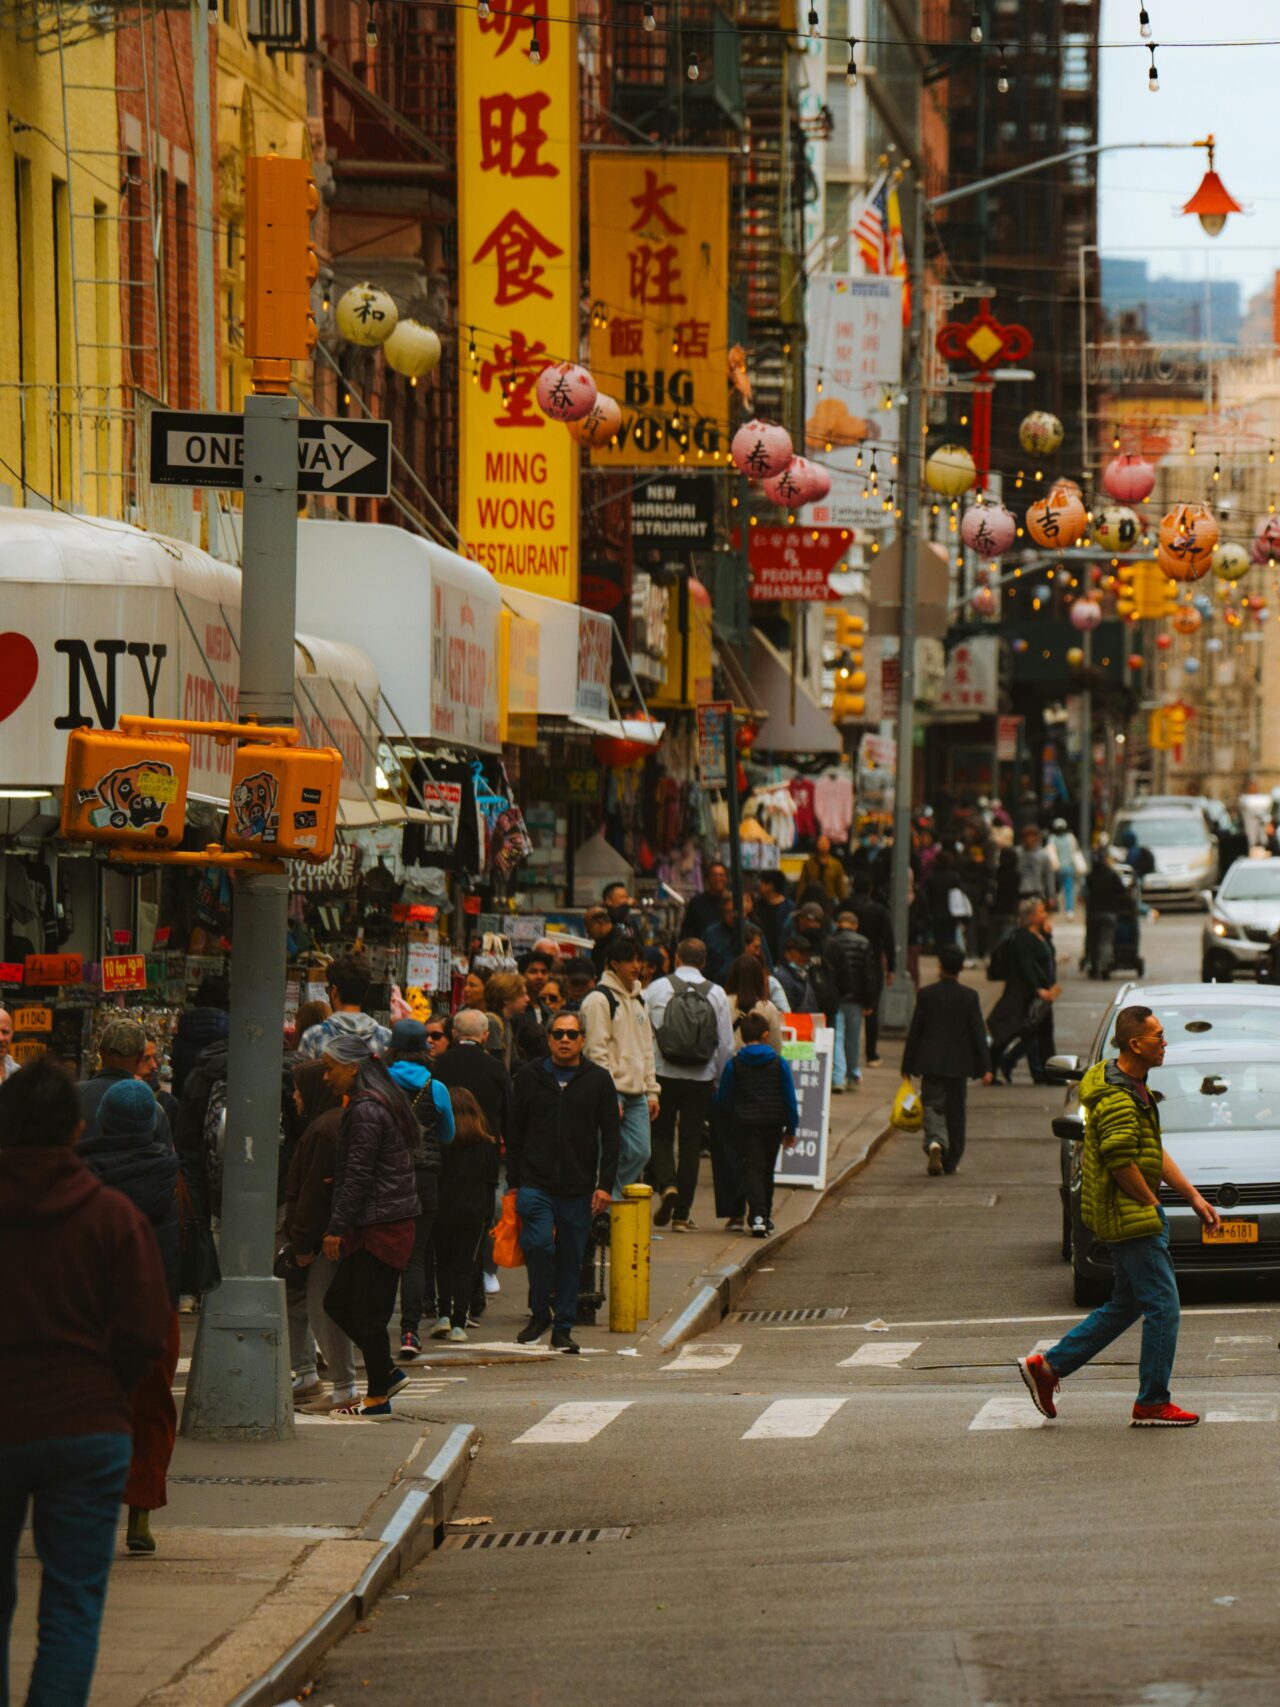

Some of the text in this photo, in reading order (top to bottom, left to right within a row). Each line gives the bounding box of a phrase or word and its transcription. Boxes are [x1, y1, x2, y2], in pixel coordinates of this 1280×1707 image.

[627, 168, 687, 306] 大旺
[353, 302, 385, 324] 和
[609, 317, 711, 359] 飯店
[550, 376, 574, 410] 春
[624, 369, 694, 407] BIG
[186, 435, 244, 465] ONE
[607, 414, 720, 454] WONG
[485, 451, 547, 484] MING
[746, 441, 771, 474] 春
[646, 484, 677, 501] NEW
[775, 471, 801, 499] 春
[477, 498, 555, 531] WONG
[632, 503, 697, 519] SHANGHAI
[1037, 507, 1061, 539] 吉
[632, 521, 708, 538] ESTAURANT
[753, 584, 829, 598] PHARMACY
[761, 568, 824, 582] PEOPLES
[54, 639, 168, 730] NY
[105, 960, 115, 978] 10
